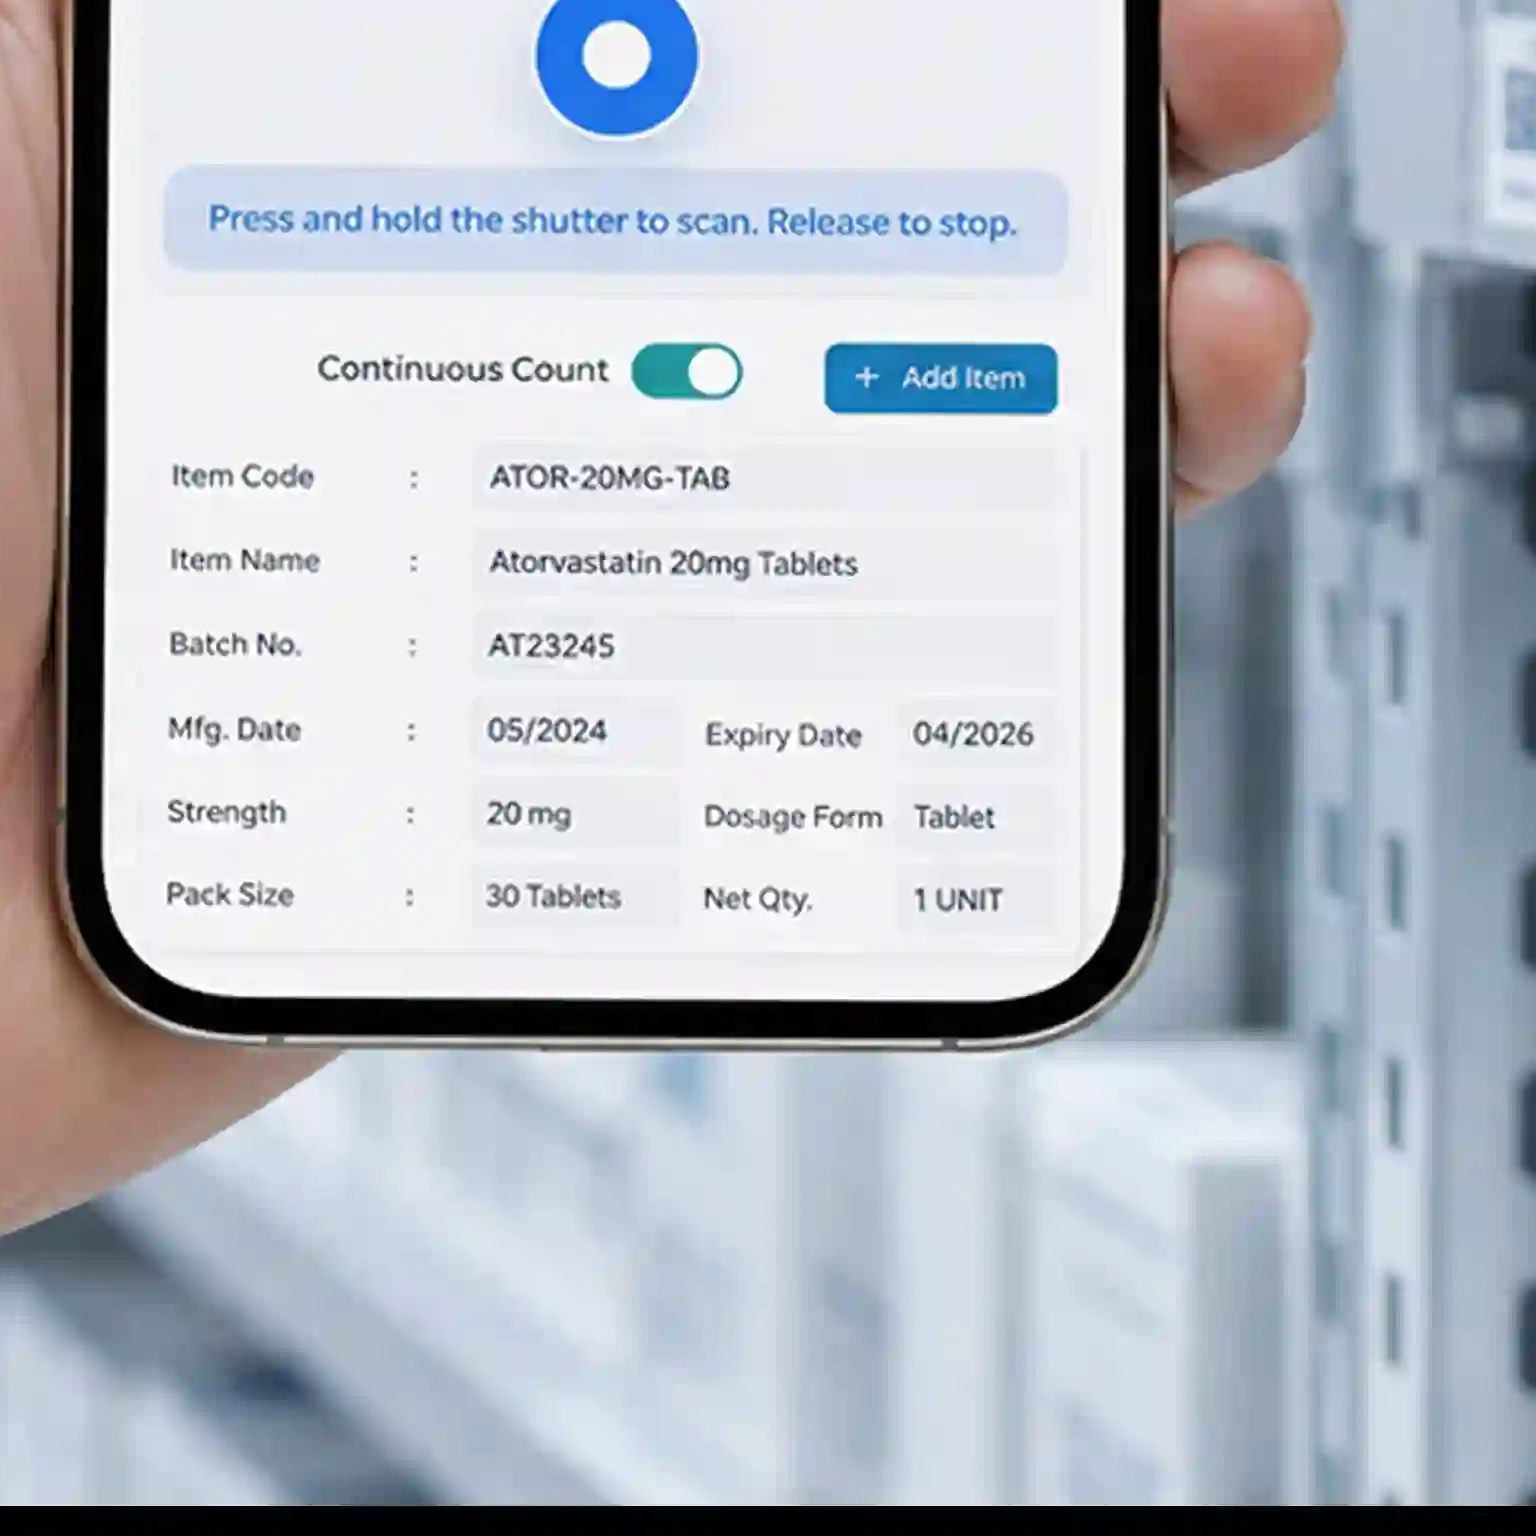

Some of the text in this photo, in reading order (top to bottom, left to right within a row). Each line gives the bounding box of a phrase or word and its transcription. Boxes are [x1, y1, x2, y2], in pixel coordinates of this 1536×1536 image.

[209, 203, 1017, 244] Press and hold the shutter to scan. Release to stop.
[317, 353, 610, 383] Continuous Count
[902, 364, 1026, 391] Add Item
[172, 463, 234, 489] Item
[240, 462, 315, 490] Code
[489, 463, 731, 491] ATOR-20MG-TAB
[170, 547, 232, 572] Item
[240, 548, 321, 574] Name
[489, 548, 662, 575] Atorvastatin
[670, 549, 751, 582] 20mg
[757, 550, 859, 577] Tablets
[169, 630, 248, 657] Batch
[256, 632, 301, 657] No.
[487, 632, 615, 660] AT23245
[168, 715, 229, 748] Mfg.
[237, 716, 302, 743] Date
[487, 716, 608, 745] 05/2024
[705, 720, 1035, 753] Expiry Date 04/2026
[167, 799, 287, 830] Strength
[487, 800, 523, 826] 20
[527, 806, 572, 833] mg
[704, 803, 996, 835] Dosage Form Tablet
[166, 880, 232, 907] Pack
[238, 880, 295, 908] Size
[486, 882, 521, 909] 30
[525, 883, 622, 910] Tablets
[704, 885, 1004, 918] Net Qty. 1 UNIT
